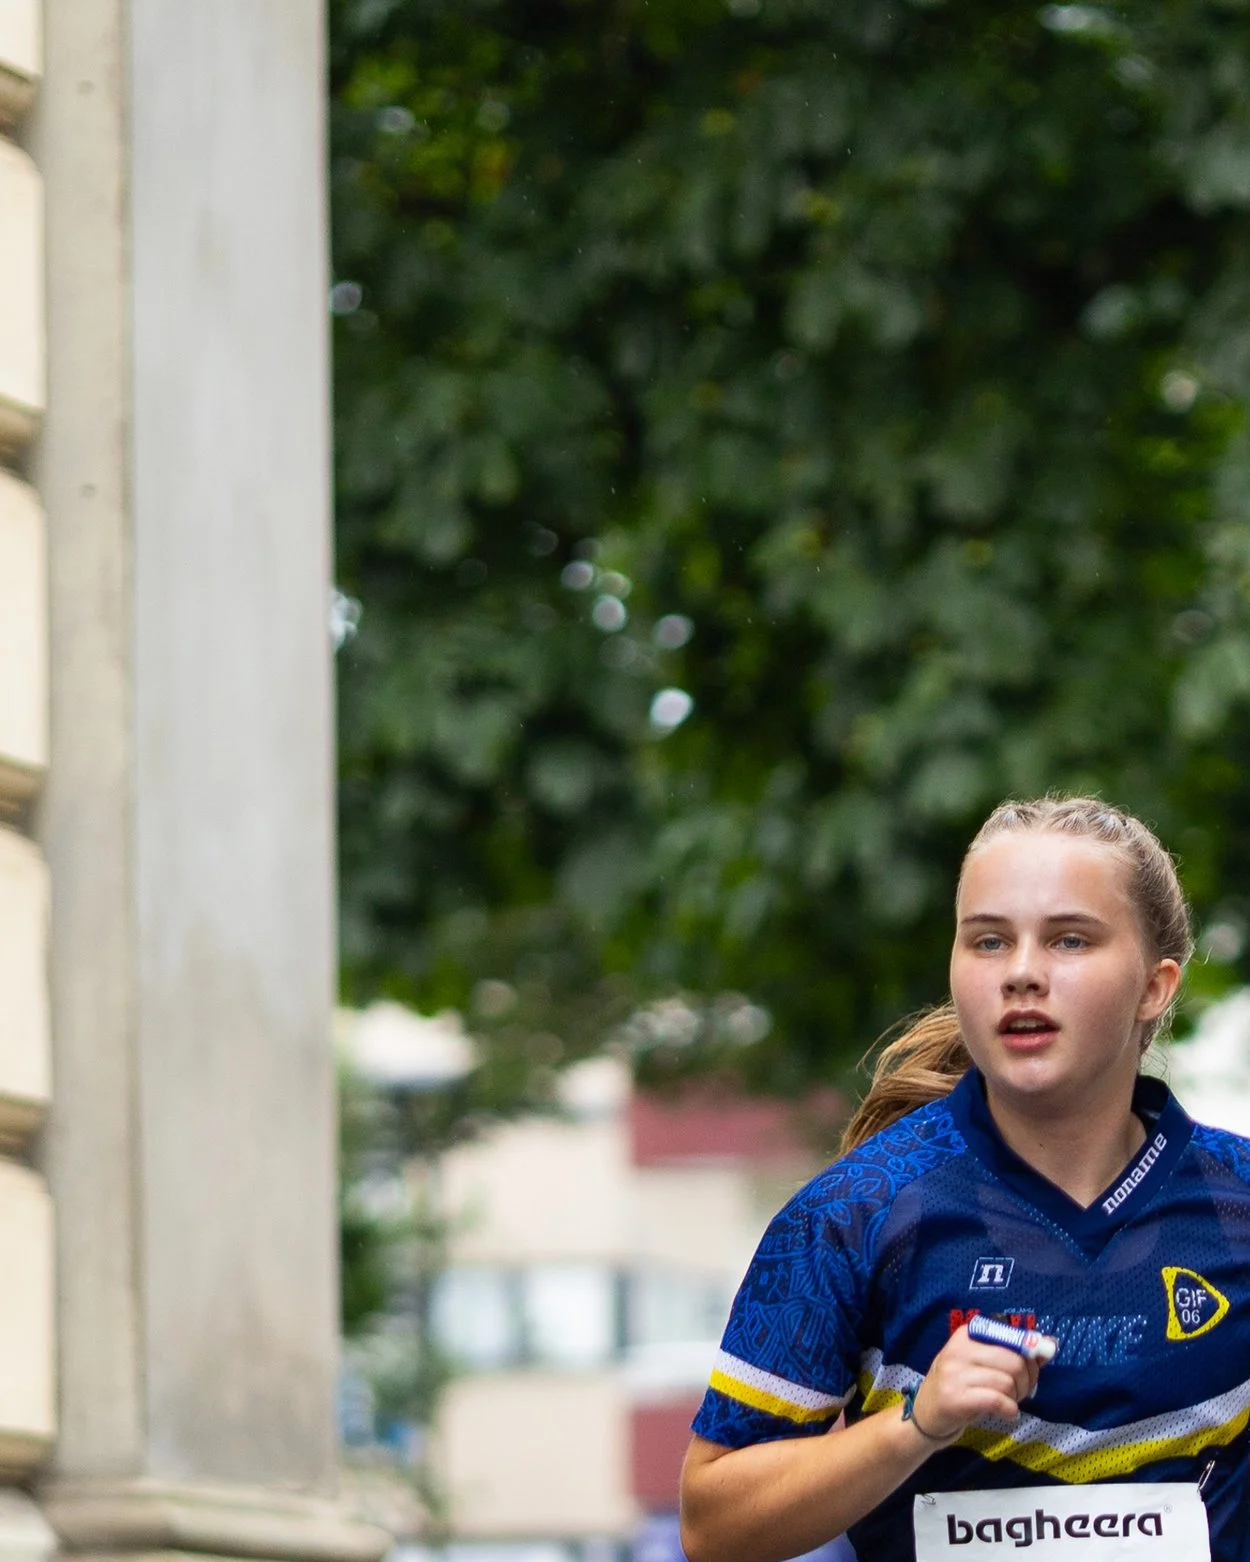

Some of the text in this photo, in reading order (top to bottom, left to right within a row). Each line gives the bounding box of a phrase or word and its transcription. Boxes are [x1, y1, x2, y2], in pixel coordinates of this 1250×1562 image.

[1102, 1133, 1168, 1215] noname
[1175, 1287, 1207, 1308] GIF
[1181, 1309, 1201, 1324] 06
[947, 1509, 1163, 1548] bagheera
